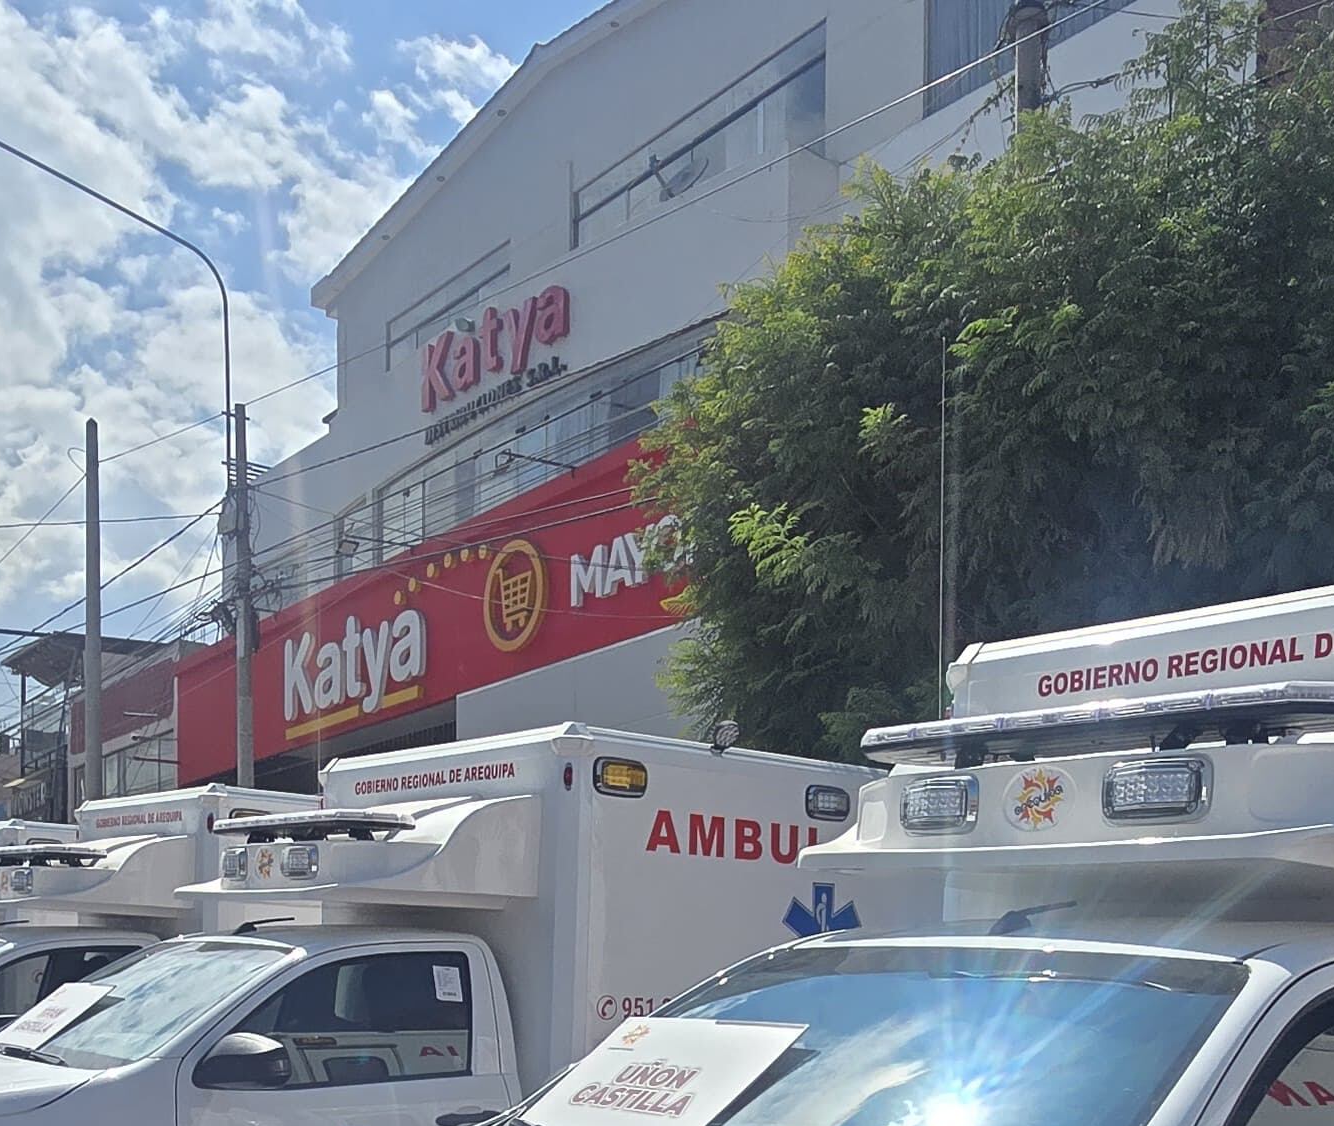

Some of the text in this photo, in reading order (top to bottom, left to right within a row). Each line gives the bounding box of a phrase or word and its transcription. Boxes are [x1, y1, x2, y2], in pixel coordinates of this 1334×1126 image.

[421, 285, 571, 413] Katya
[284, 609, 427, 721] Katya
[1038, 659, 1159, 697] GOBIERNO
[1166, 637, 1304, 677] REGIONAL
[355, 763, 515, 796] GOBIERNO REGIONAL DE AREQUIPA
[622, 998, 654, 1018] 951
[617, 1062, 698, 1089] UÑON
[570, 1083, 694, 1117] CASTILLA
